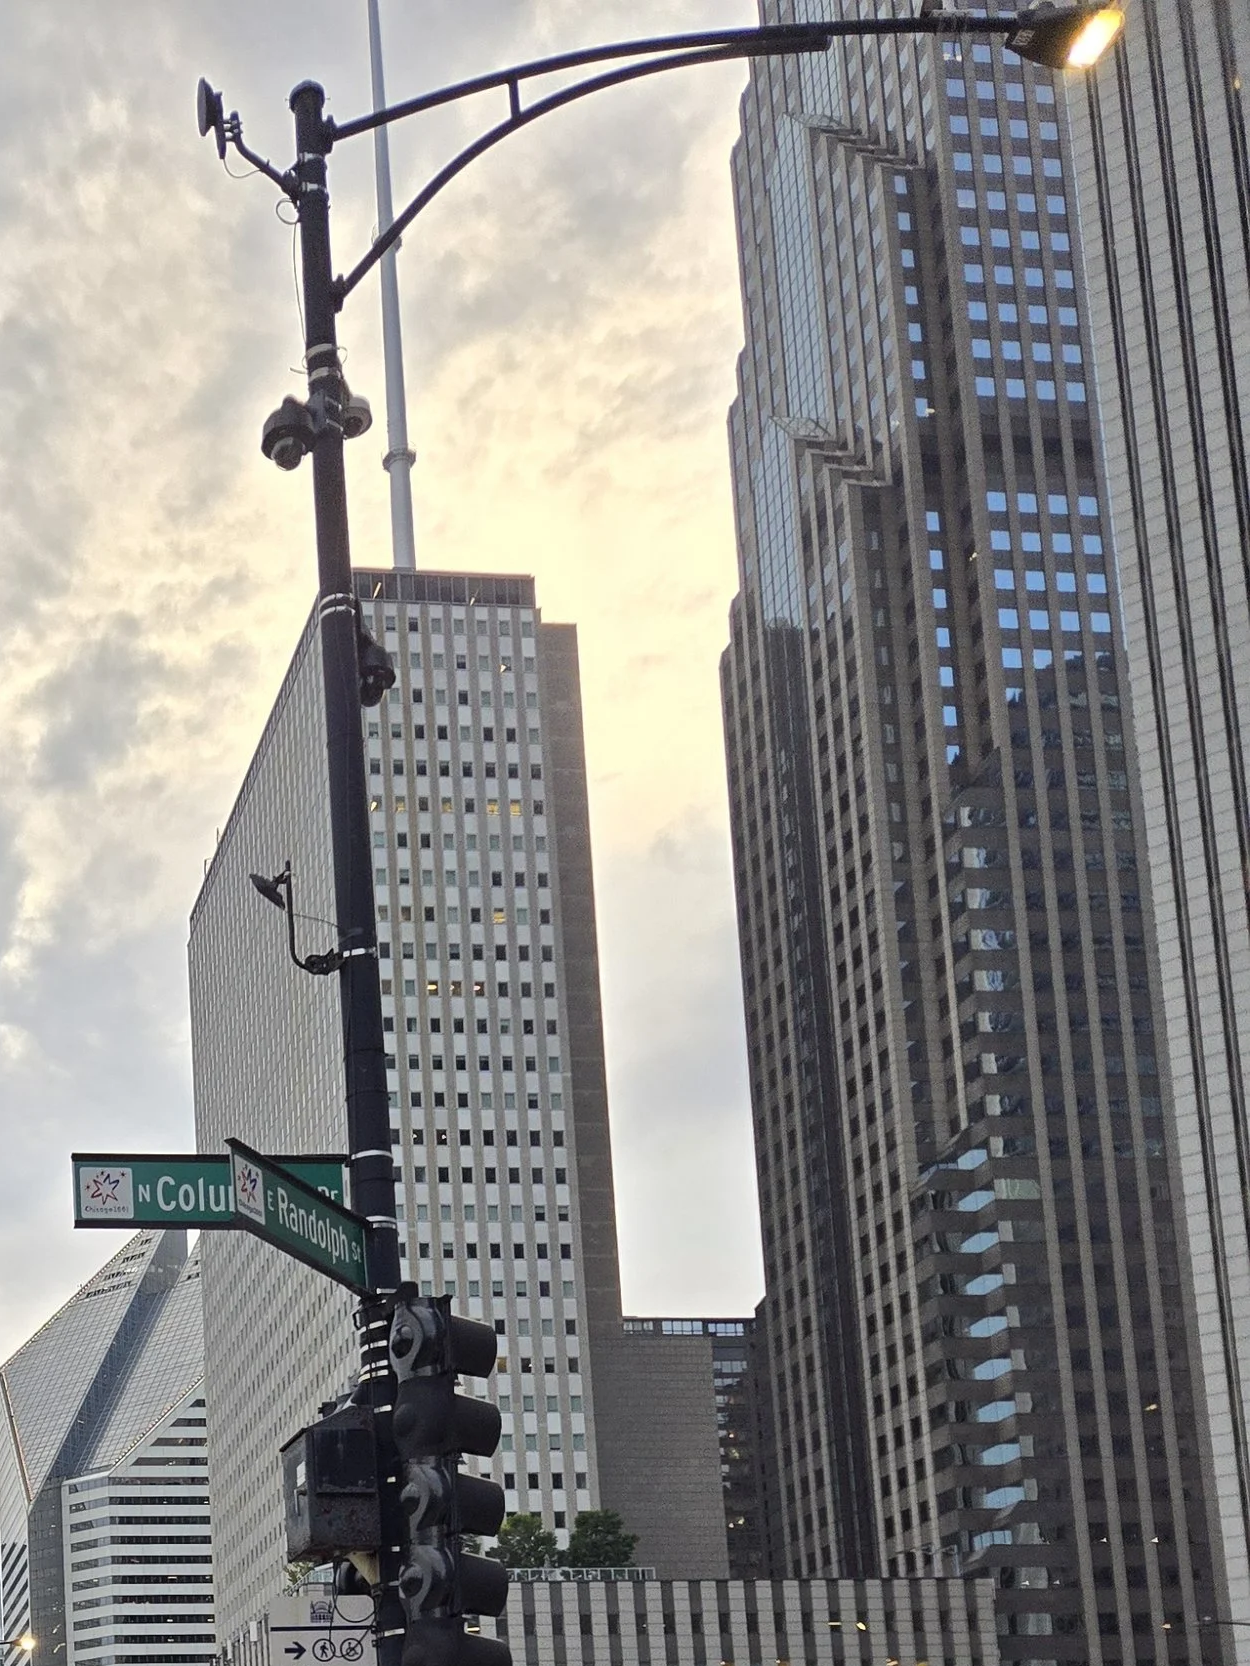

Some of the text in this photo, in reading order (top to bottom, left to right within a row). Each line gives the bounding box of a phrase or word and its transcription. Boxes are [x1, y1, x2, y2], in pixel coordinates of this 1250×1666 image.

[138, 1183, 151, 1203] N
[267, 1189, 275, 1211] E
[277, 1187, 350, 1265] Randolph
